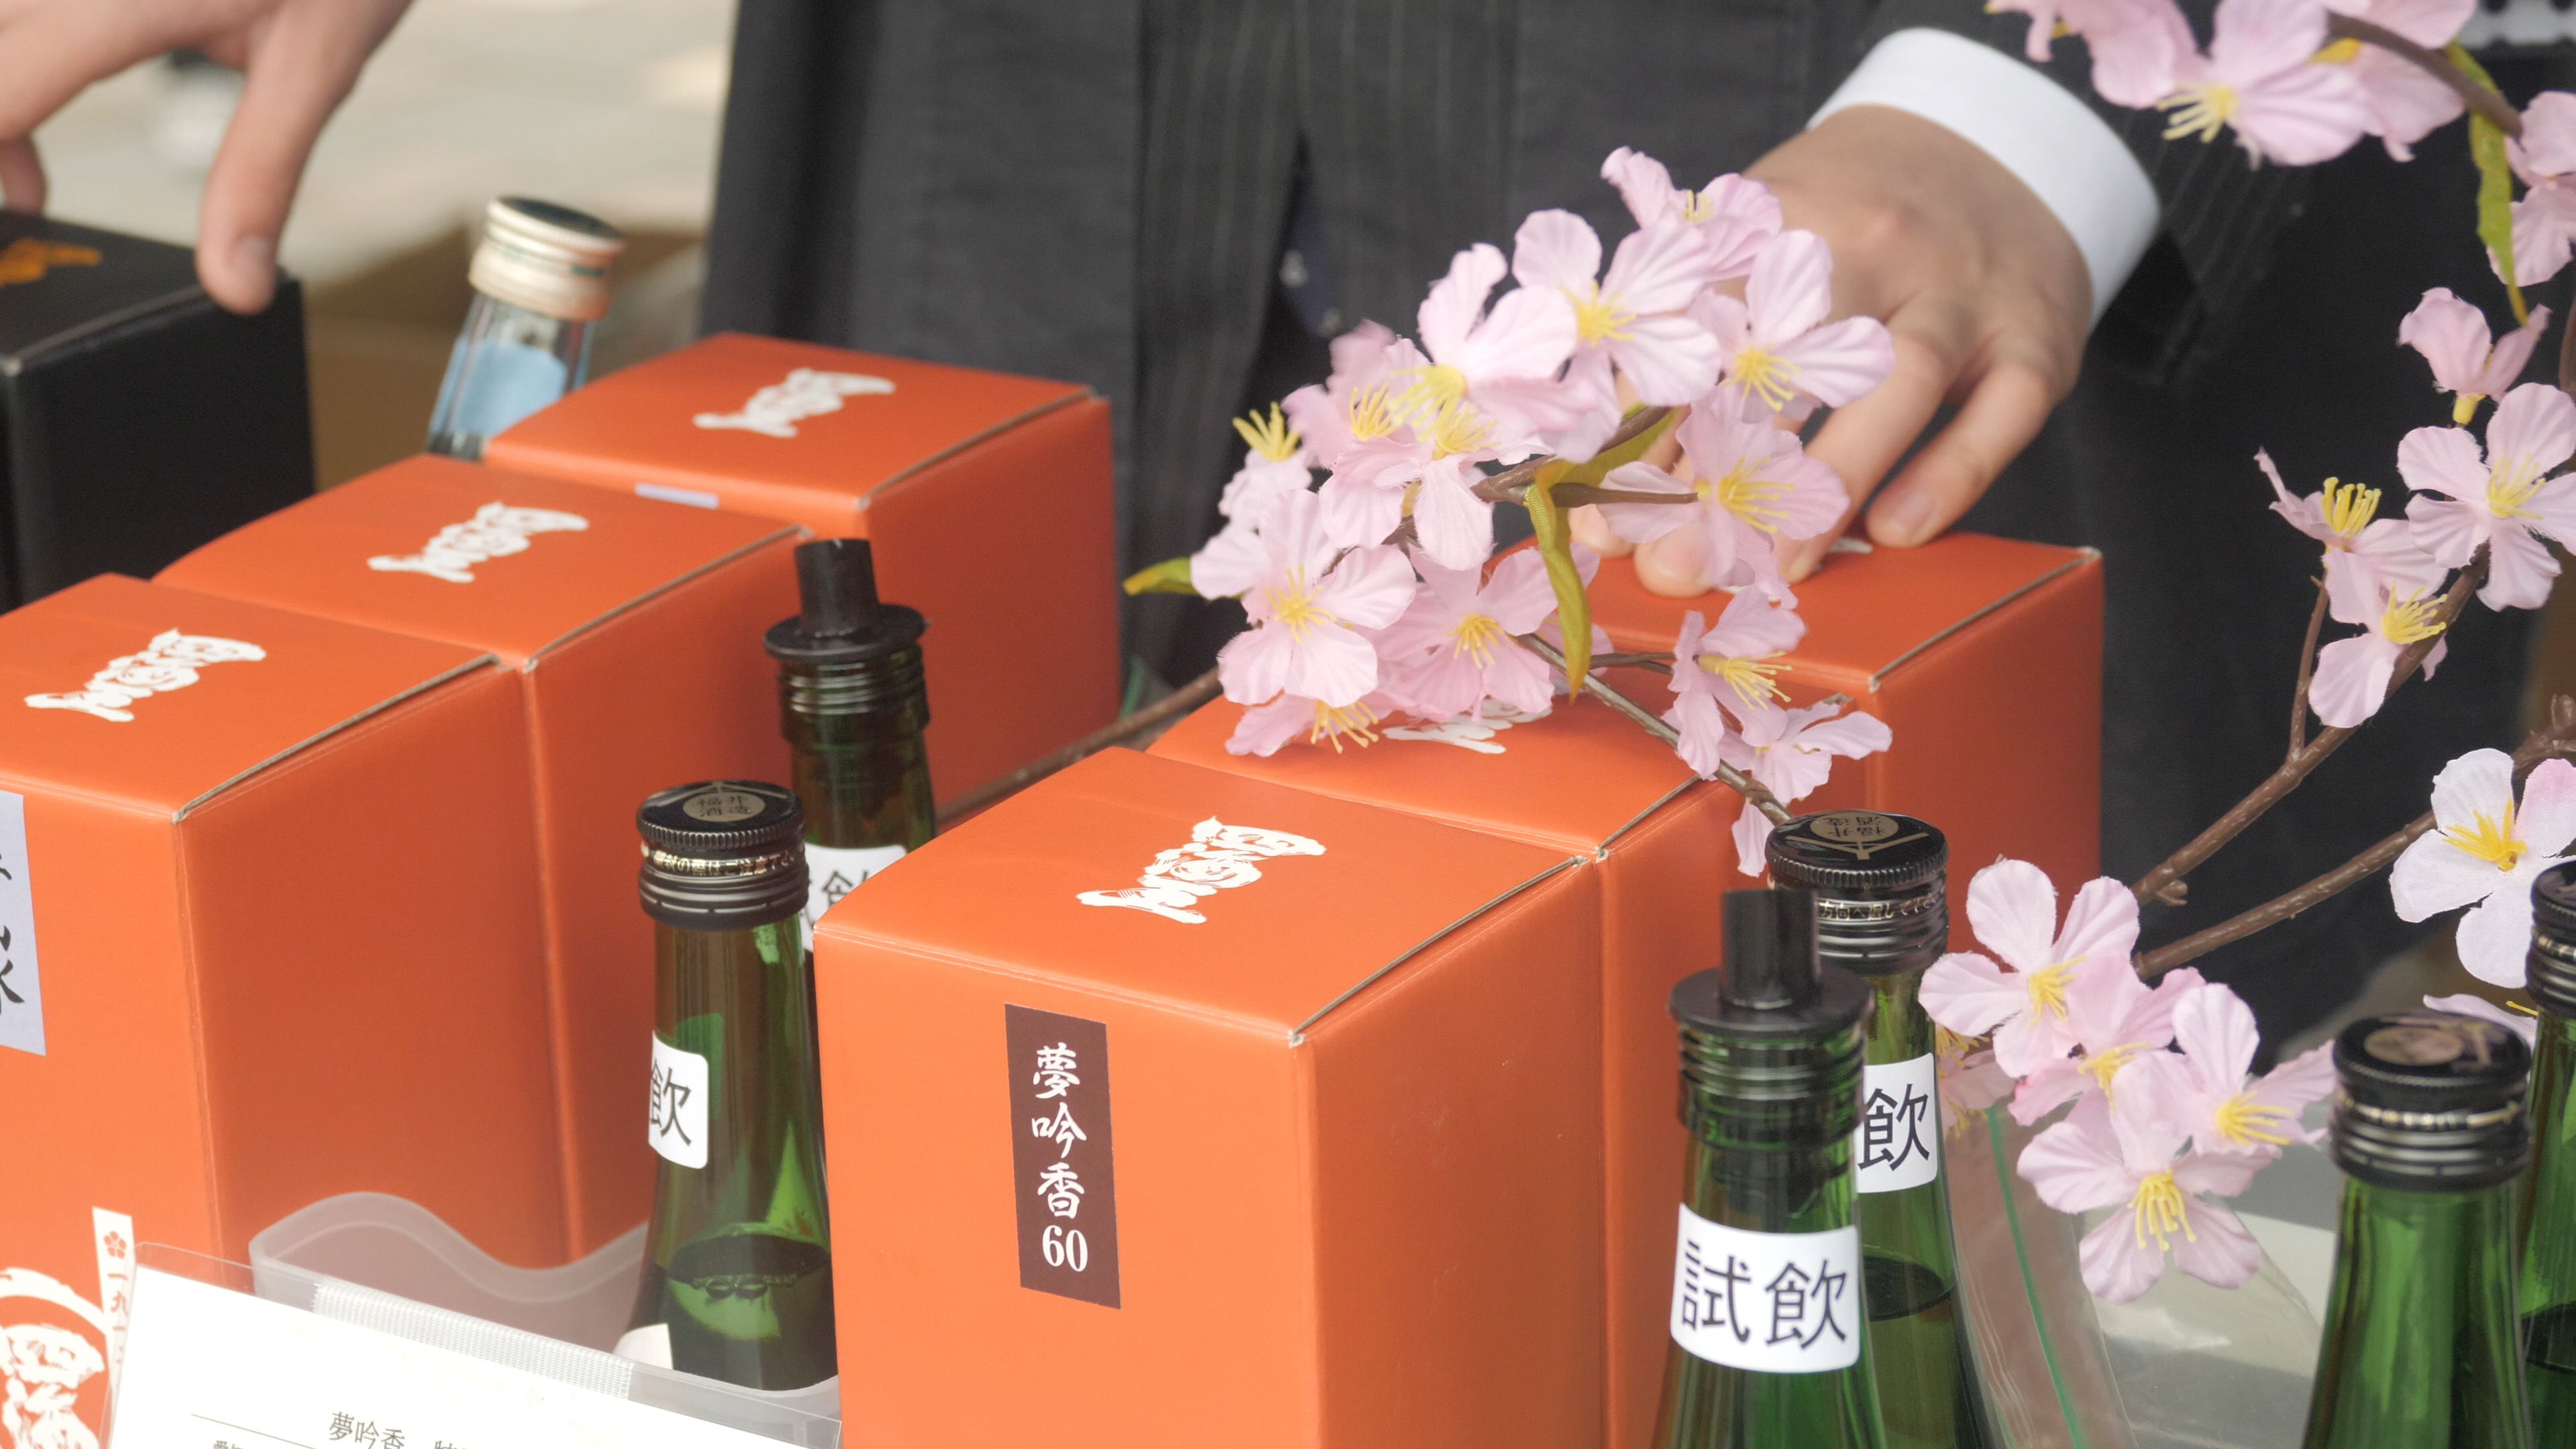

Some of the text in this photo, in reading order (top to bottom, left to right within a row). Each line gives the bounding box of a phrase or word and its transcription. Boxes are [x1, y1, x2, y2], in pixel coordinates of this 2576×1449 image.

[1682, 1239, 1847, 1349] 試飲
[329, 1411, 405, 1449] 夢吟香
